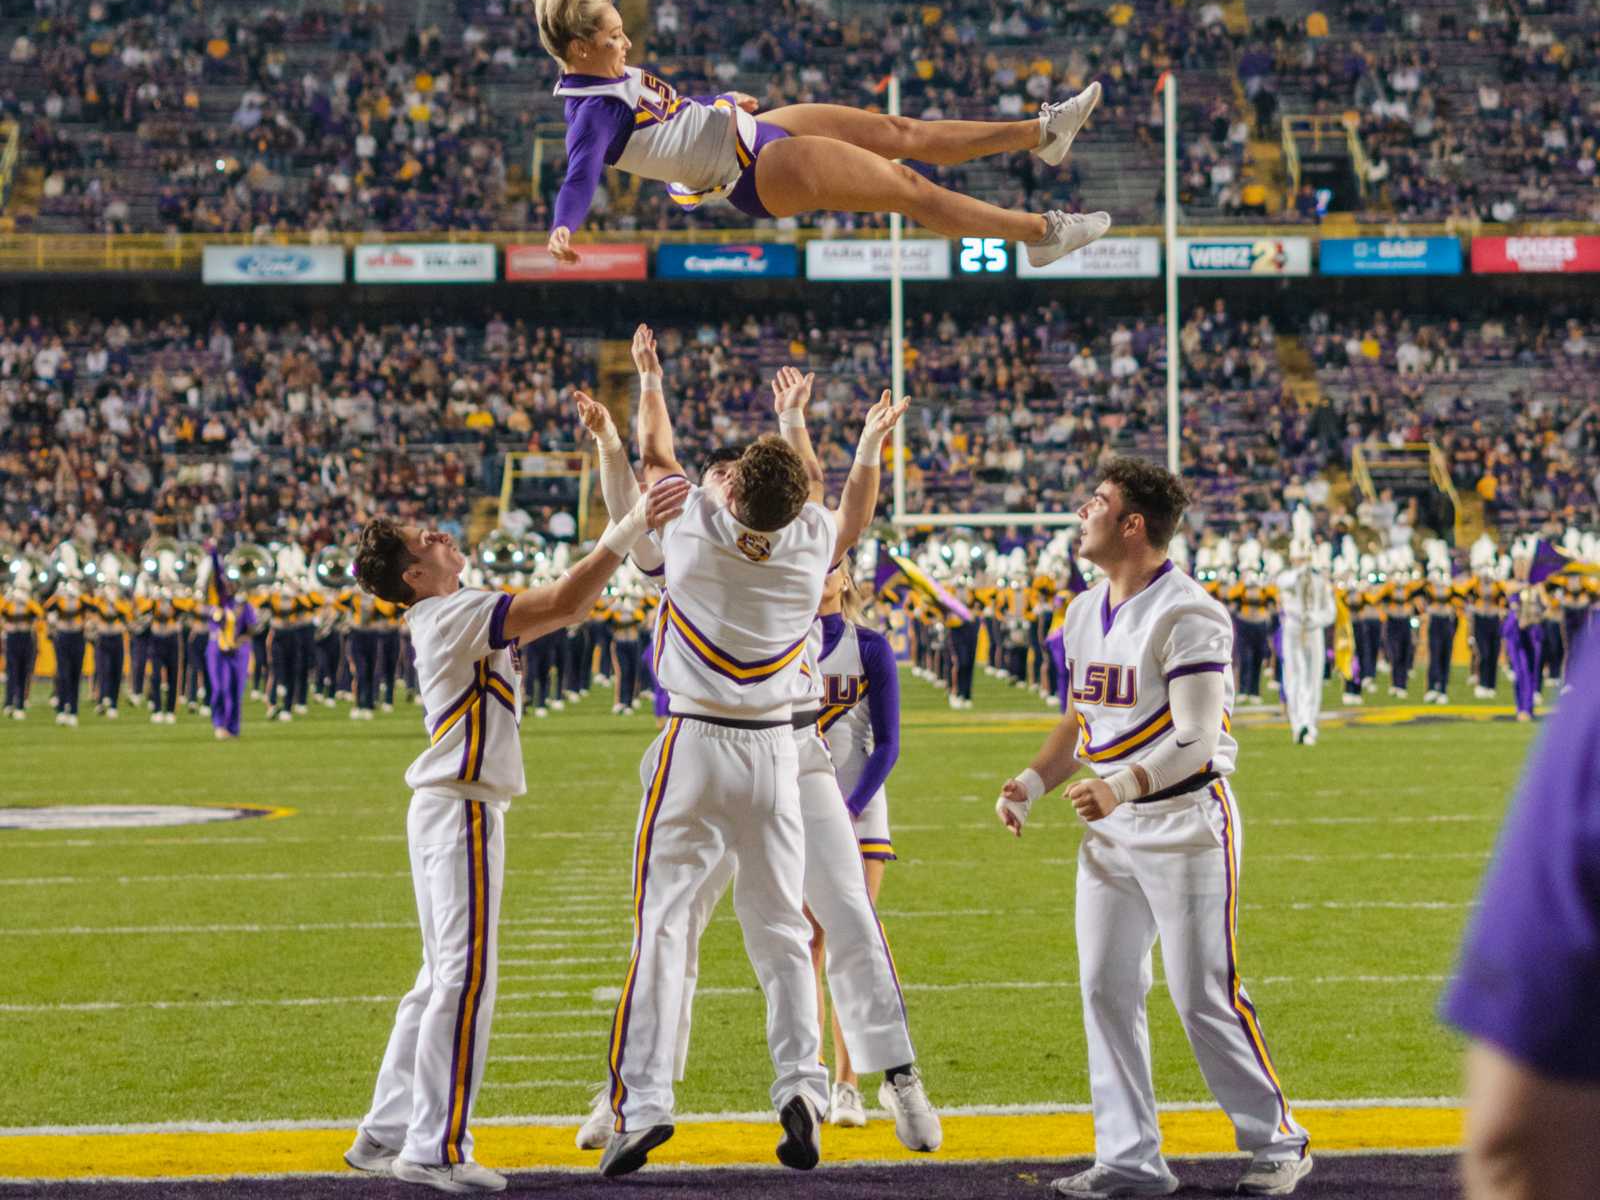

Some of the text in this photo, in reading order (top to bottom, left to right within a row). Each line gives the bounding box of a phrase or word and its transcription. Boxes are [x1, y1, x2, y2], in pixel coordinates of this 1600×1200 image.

[960, 237, 1007, 272] 25
[1189, 243, 1249, 270] WBRZ
[1068, 659, 1137, 708] LSU
